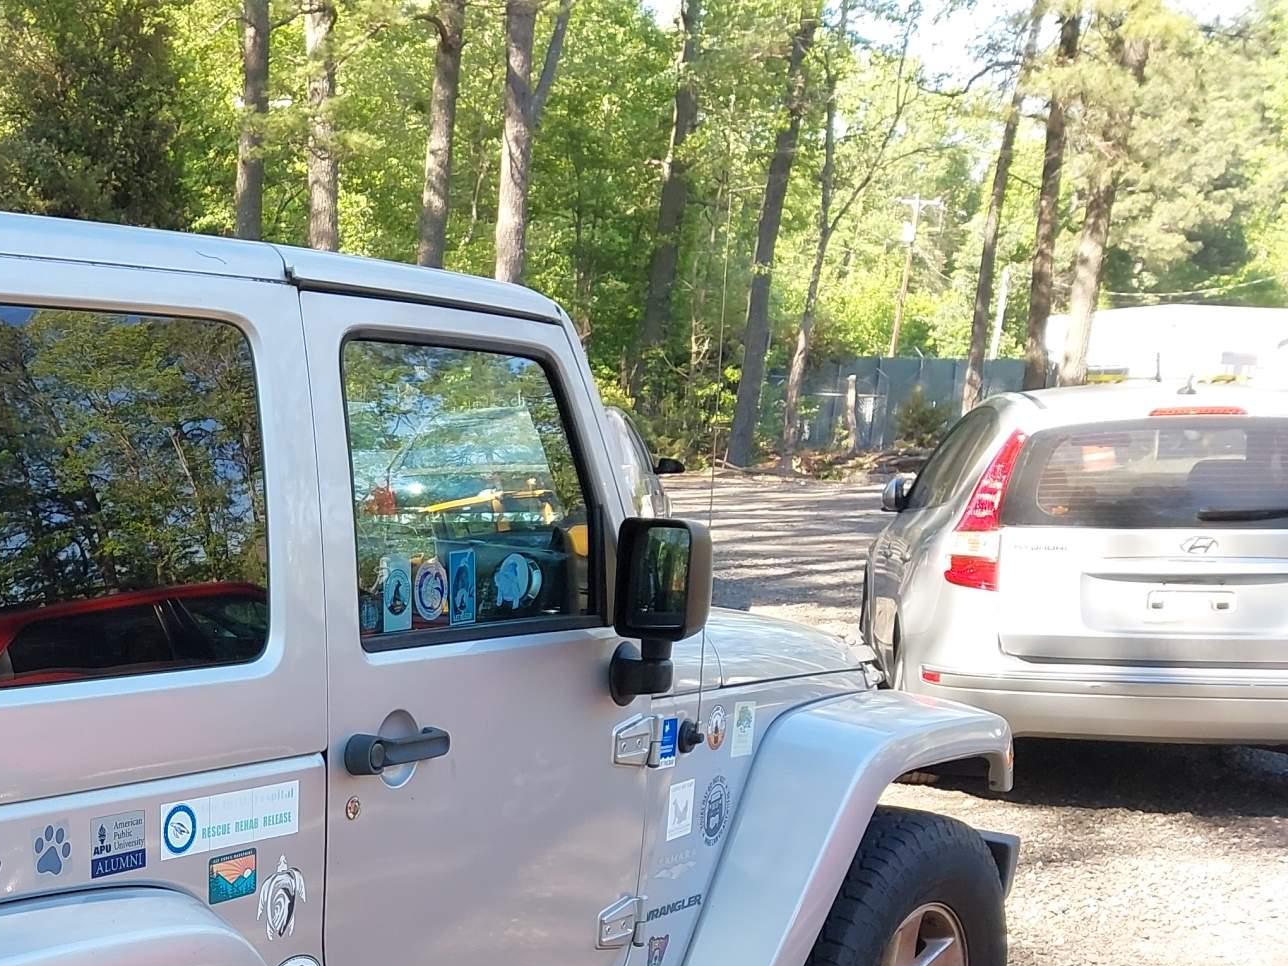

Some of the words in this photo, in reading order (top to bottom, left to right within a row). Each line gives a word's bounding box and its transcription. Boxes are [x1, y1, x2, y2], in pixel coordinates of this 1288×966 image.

[113, 817, 143, 830] American
[201, 823, 231, 839] RESCUE
[263, 811, 292, 827] RELEASE
[113, 830, 133, 840] Public
[93, 843, 112, 856] APU
[113, 838, 145, 851] University
[95, 852, 143, 875] ALUMNI
